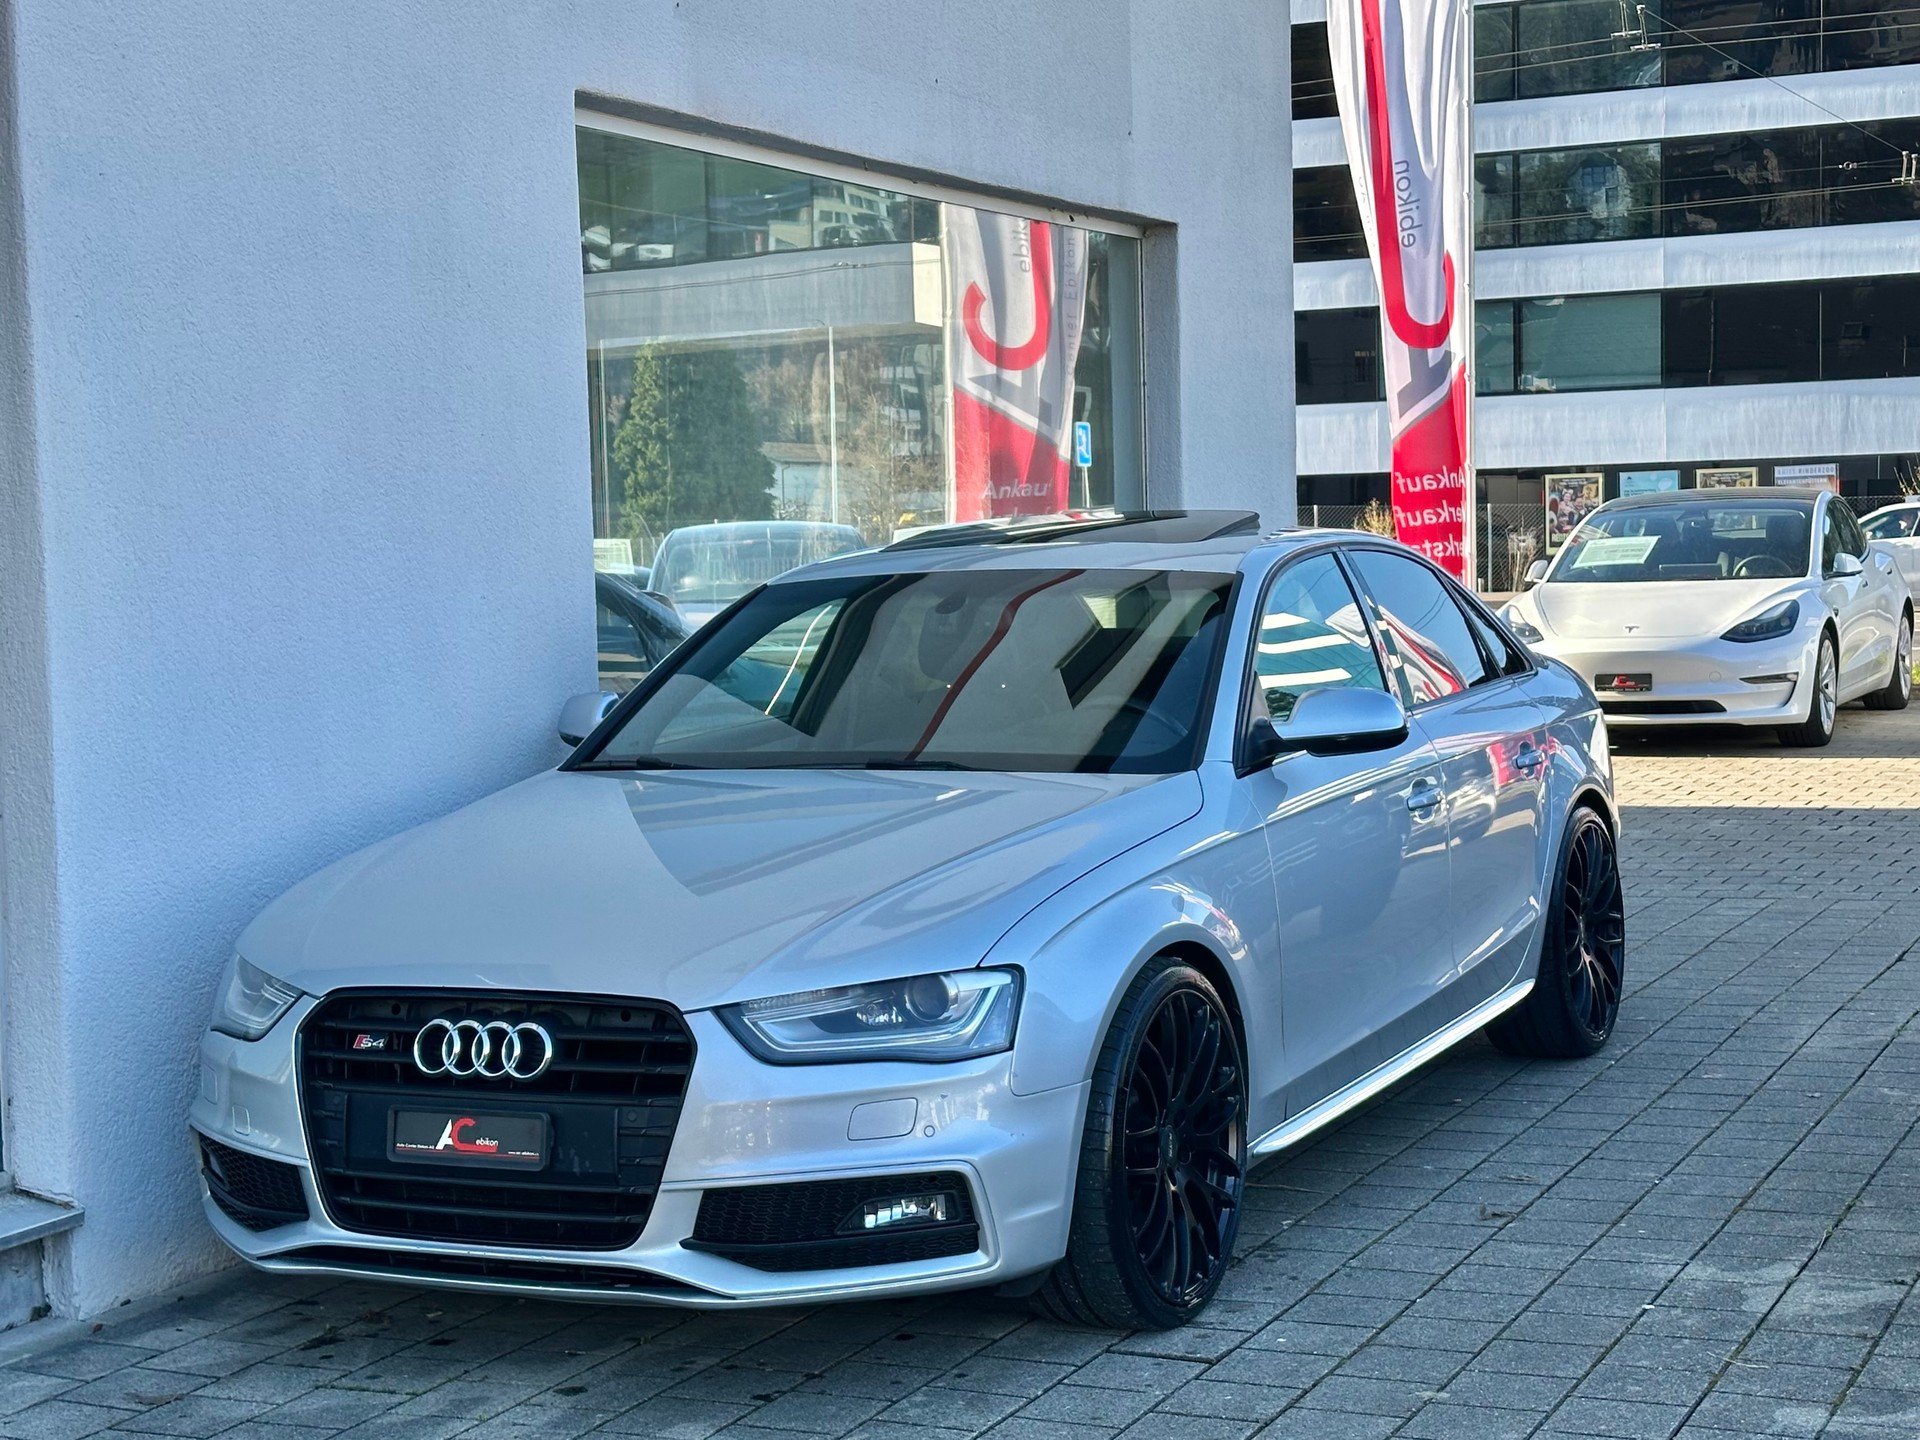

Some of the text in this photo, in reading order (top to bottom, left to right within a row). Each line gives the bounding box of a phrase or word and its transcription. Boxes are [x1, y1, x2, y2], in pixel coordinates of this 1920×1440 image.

[1011, 217, 1031, 273] ebik
[980, 478, 1052, 500] Ankau
[476, 1136, 499, 1147] ebikon
